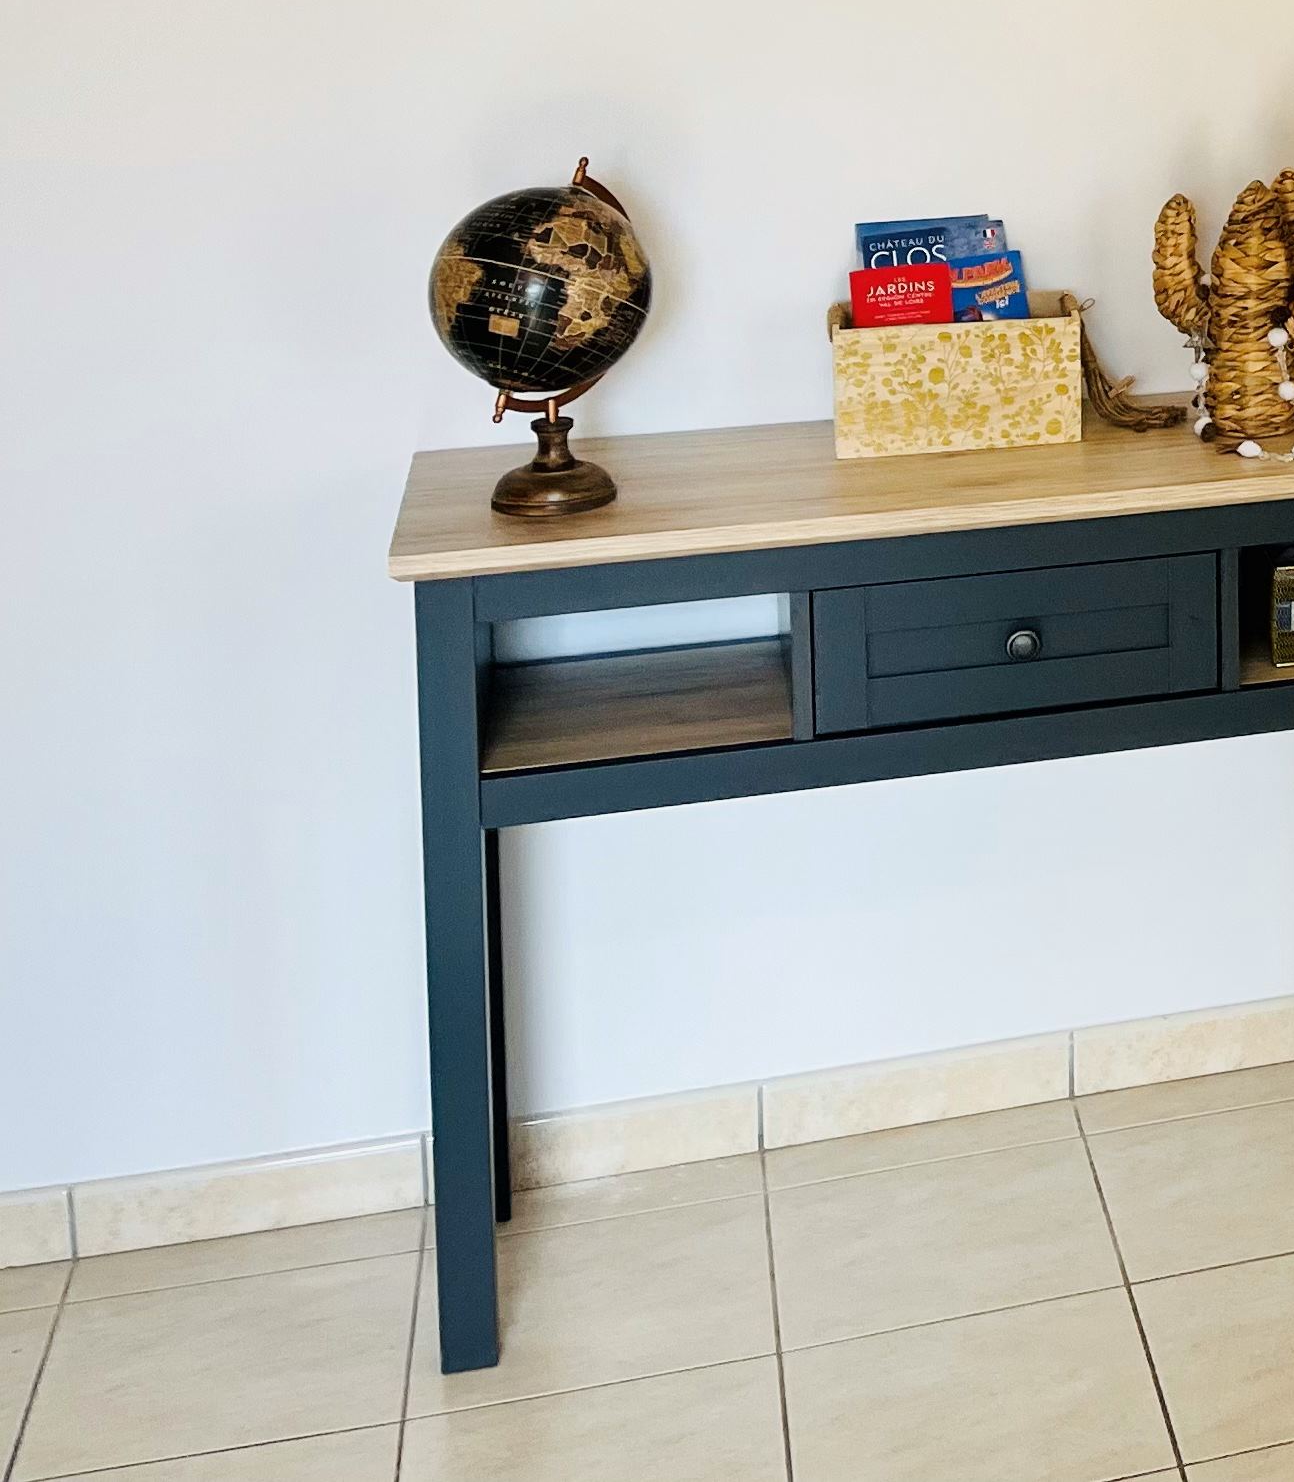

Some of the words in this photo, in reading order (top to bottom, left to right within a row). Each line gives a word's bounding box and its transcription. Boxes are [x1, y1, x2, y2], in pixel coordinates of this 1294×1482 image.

[869, 237, 924, 252] CHÂTEAU
[928, 234, 945, 245] DU
[867, 280, 935, 297] JARDINS
